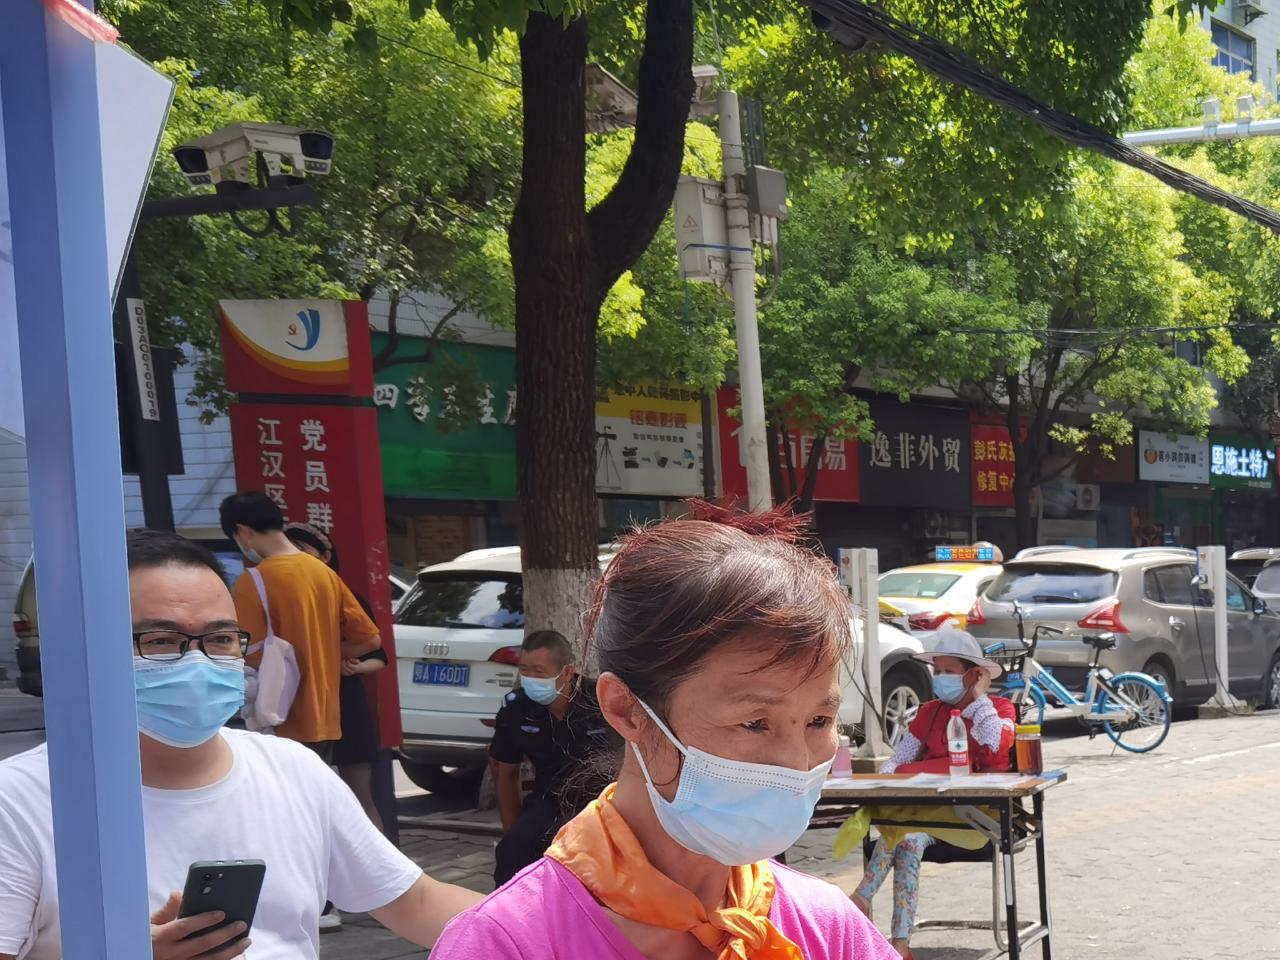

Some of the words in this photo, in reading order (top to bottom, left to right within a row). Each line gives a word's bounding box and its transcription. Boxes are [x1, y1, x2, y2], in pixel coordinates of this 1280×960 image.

[257, 417, 288, 524] 江汉区
[869, 431, 960, 473] 逸菲外贸
